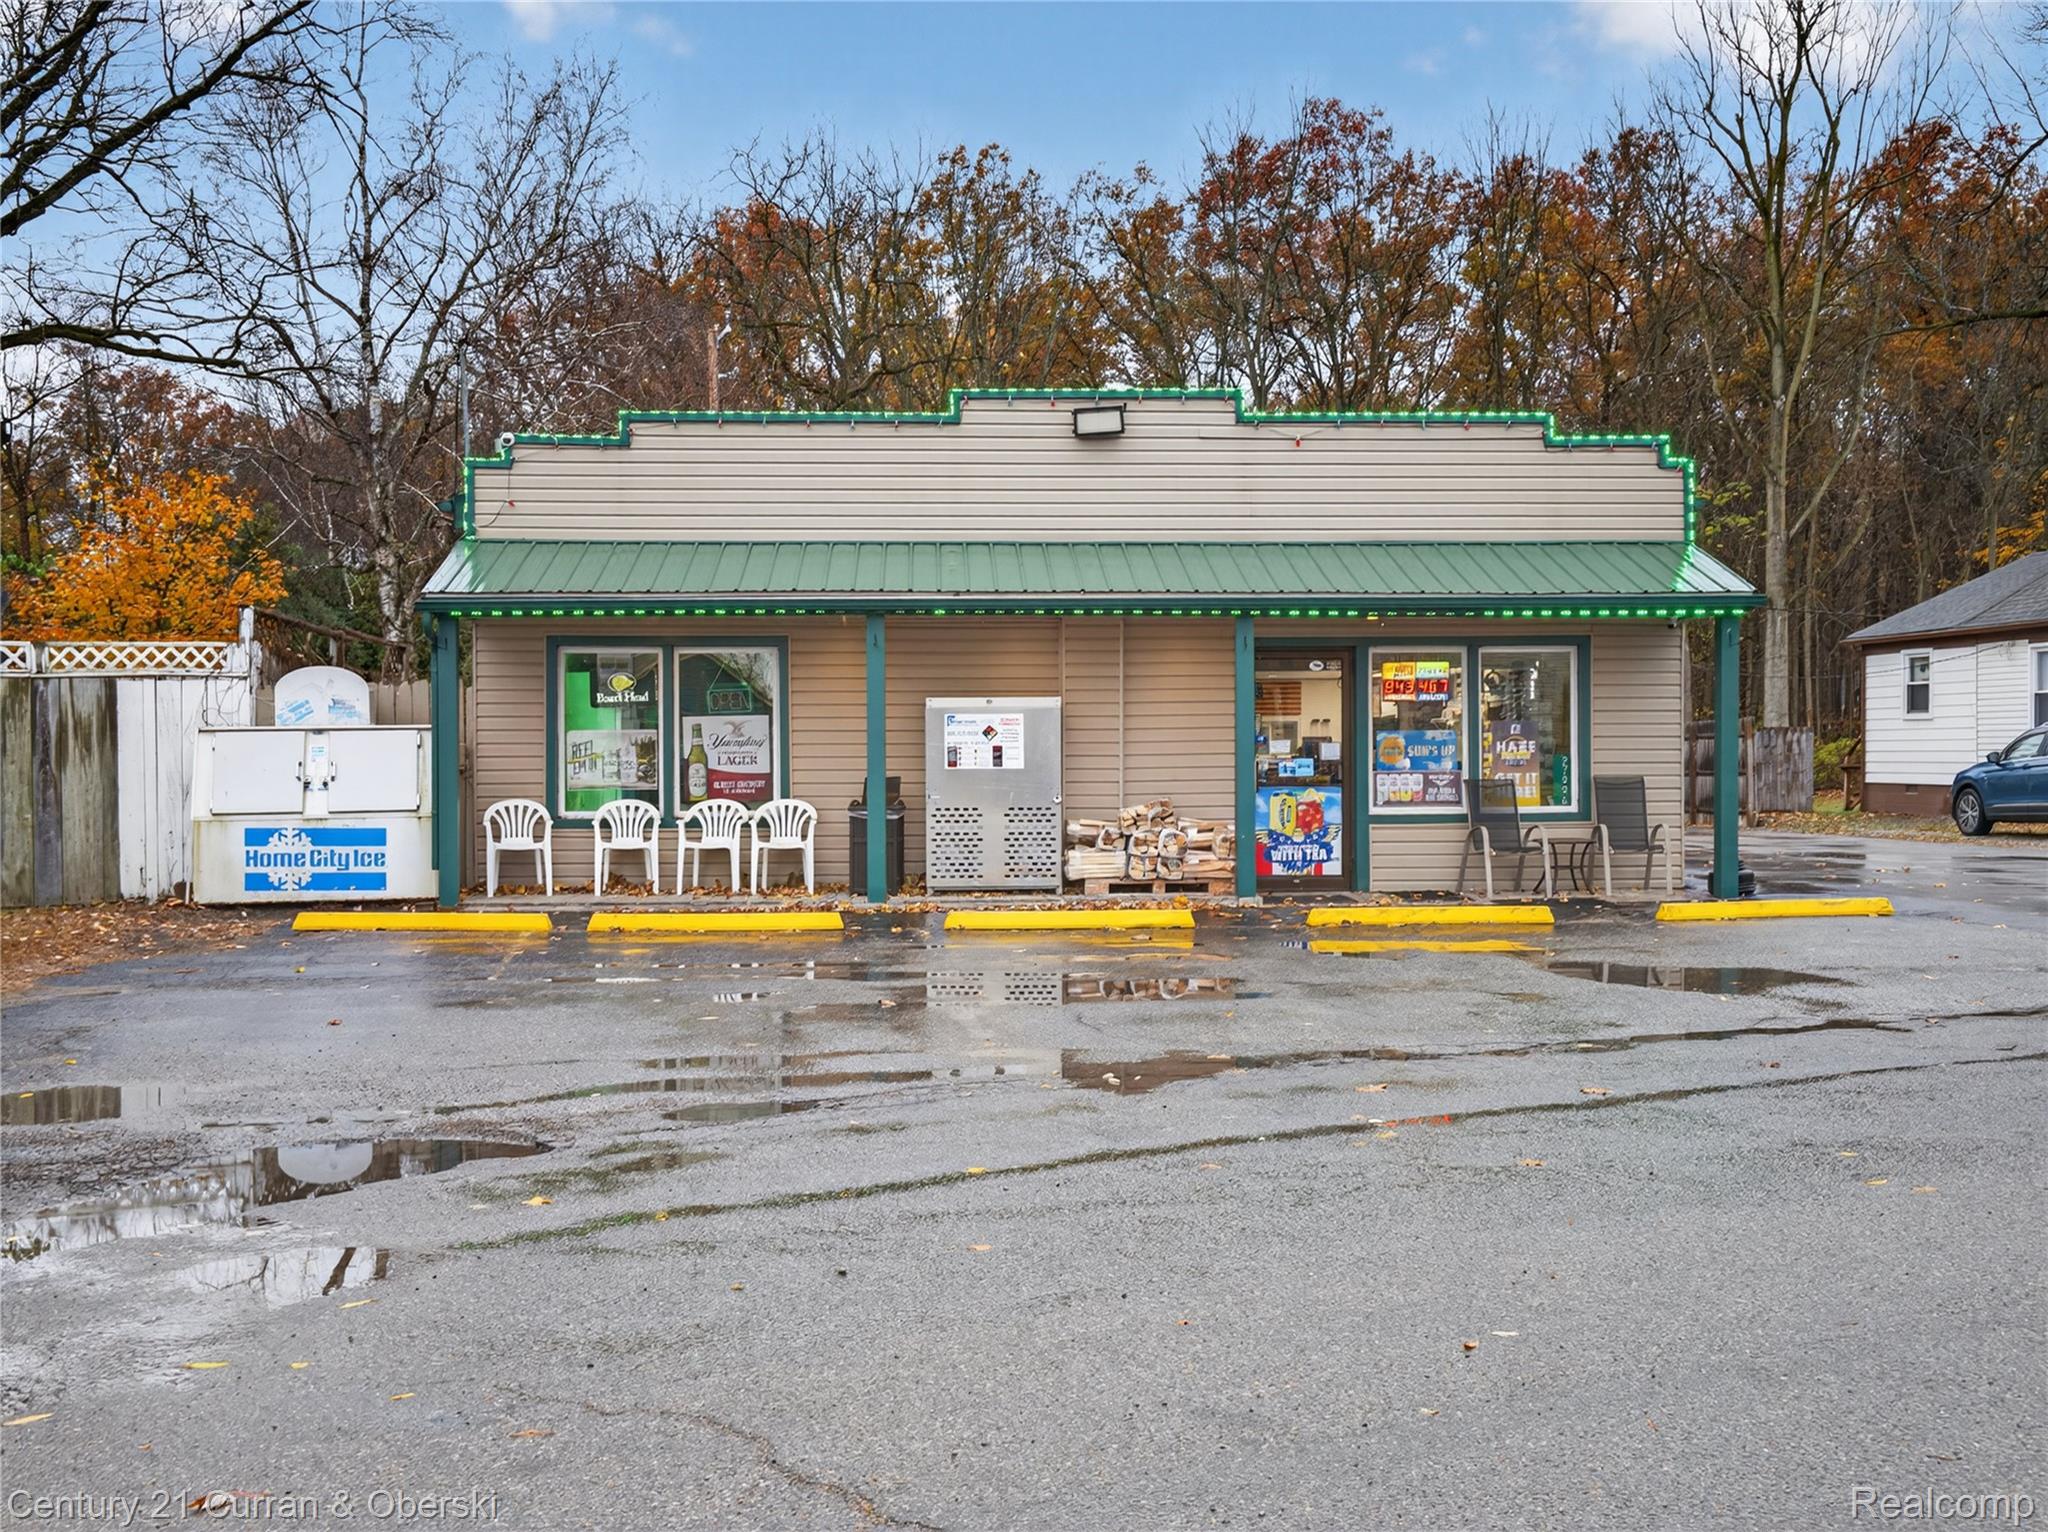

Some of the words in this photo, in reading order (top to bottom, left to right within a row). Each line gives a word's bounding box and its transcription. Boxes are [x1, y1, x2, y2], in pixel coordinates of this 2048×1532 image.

[245, 849, 306, 868] Home
[309, 849, 350, 871] City
[353, 849, 386, 867] Ice
